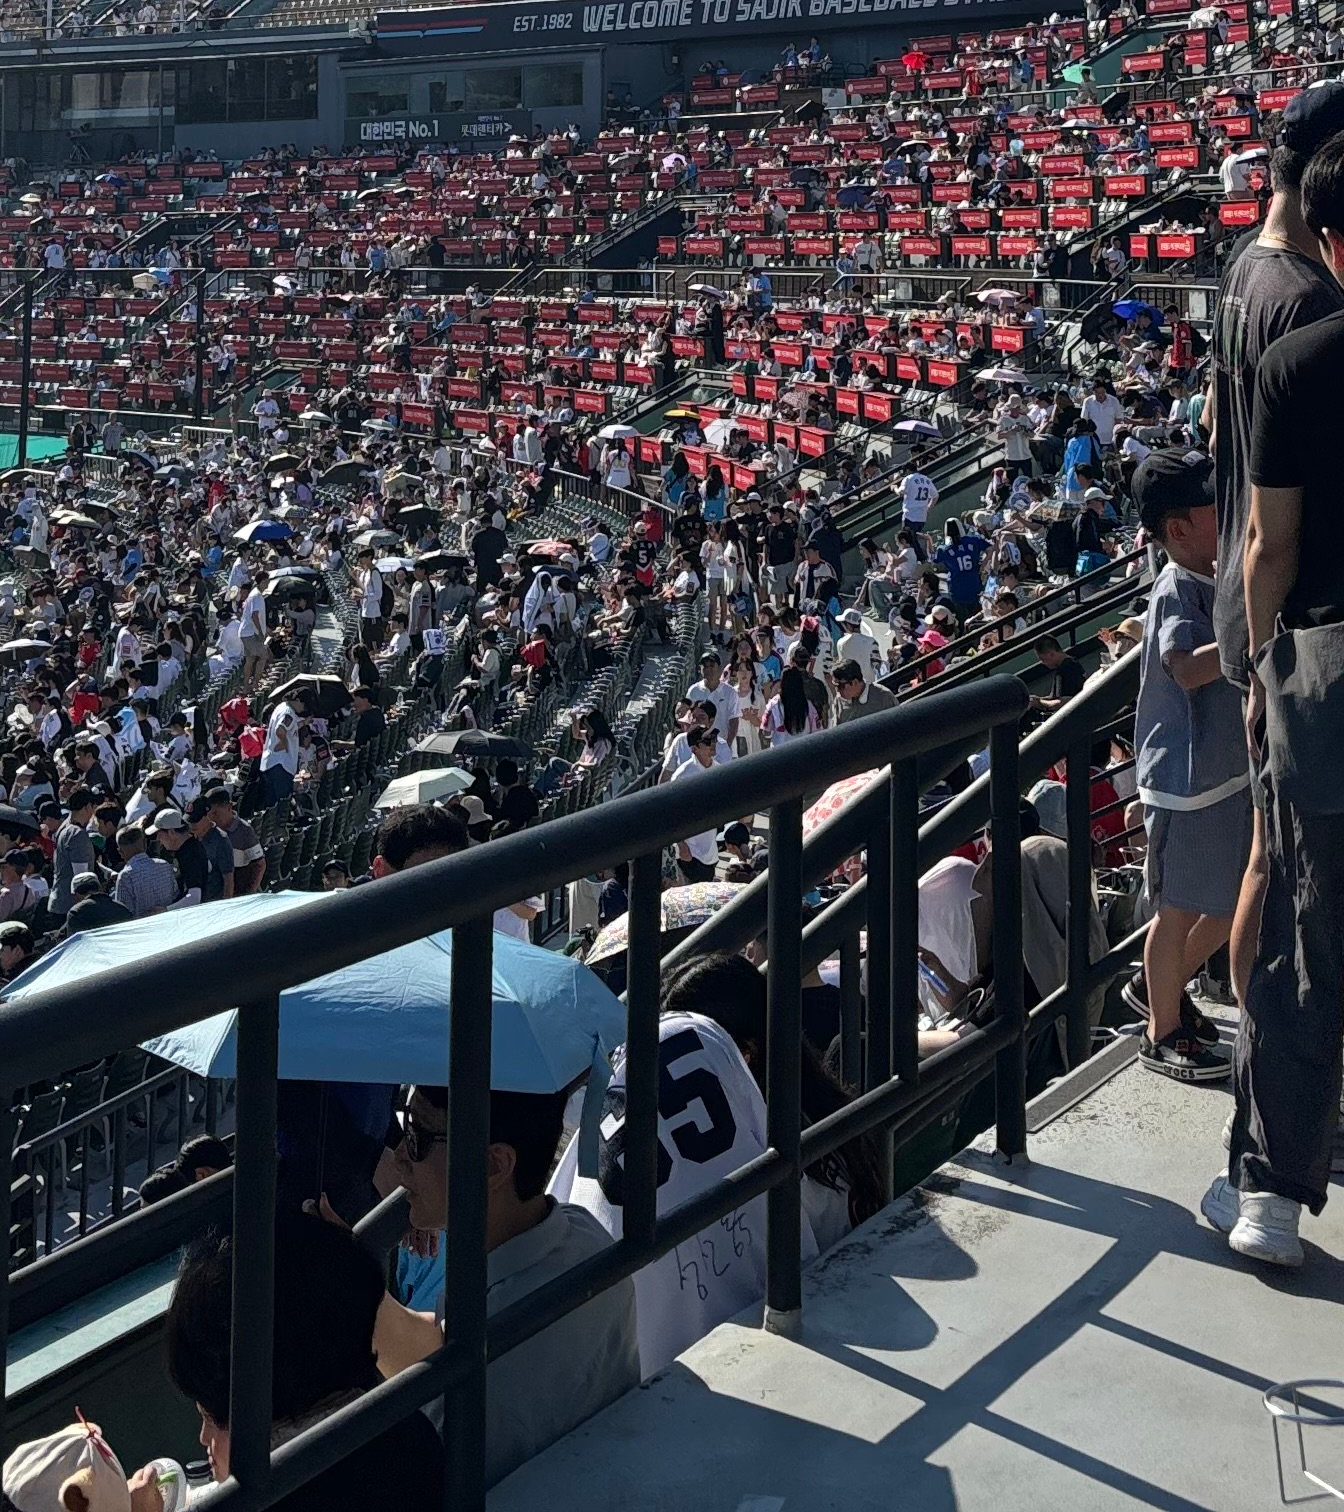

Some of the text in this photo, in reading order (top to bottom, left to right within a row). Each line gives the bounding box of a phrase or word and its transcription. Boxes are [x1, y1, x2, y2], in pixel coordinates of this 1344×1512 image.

[512, 13, 574, 33] EST.1982
[360, 119, 439, 141] 대한민국 No.1
[914, 486, 930, 501] 13
[638, 549, 648, 564] 5
[956, 554, 973, 572] 16
[1162, 1064, 1196, 1080] crocs
